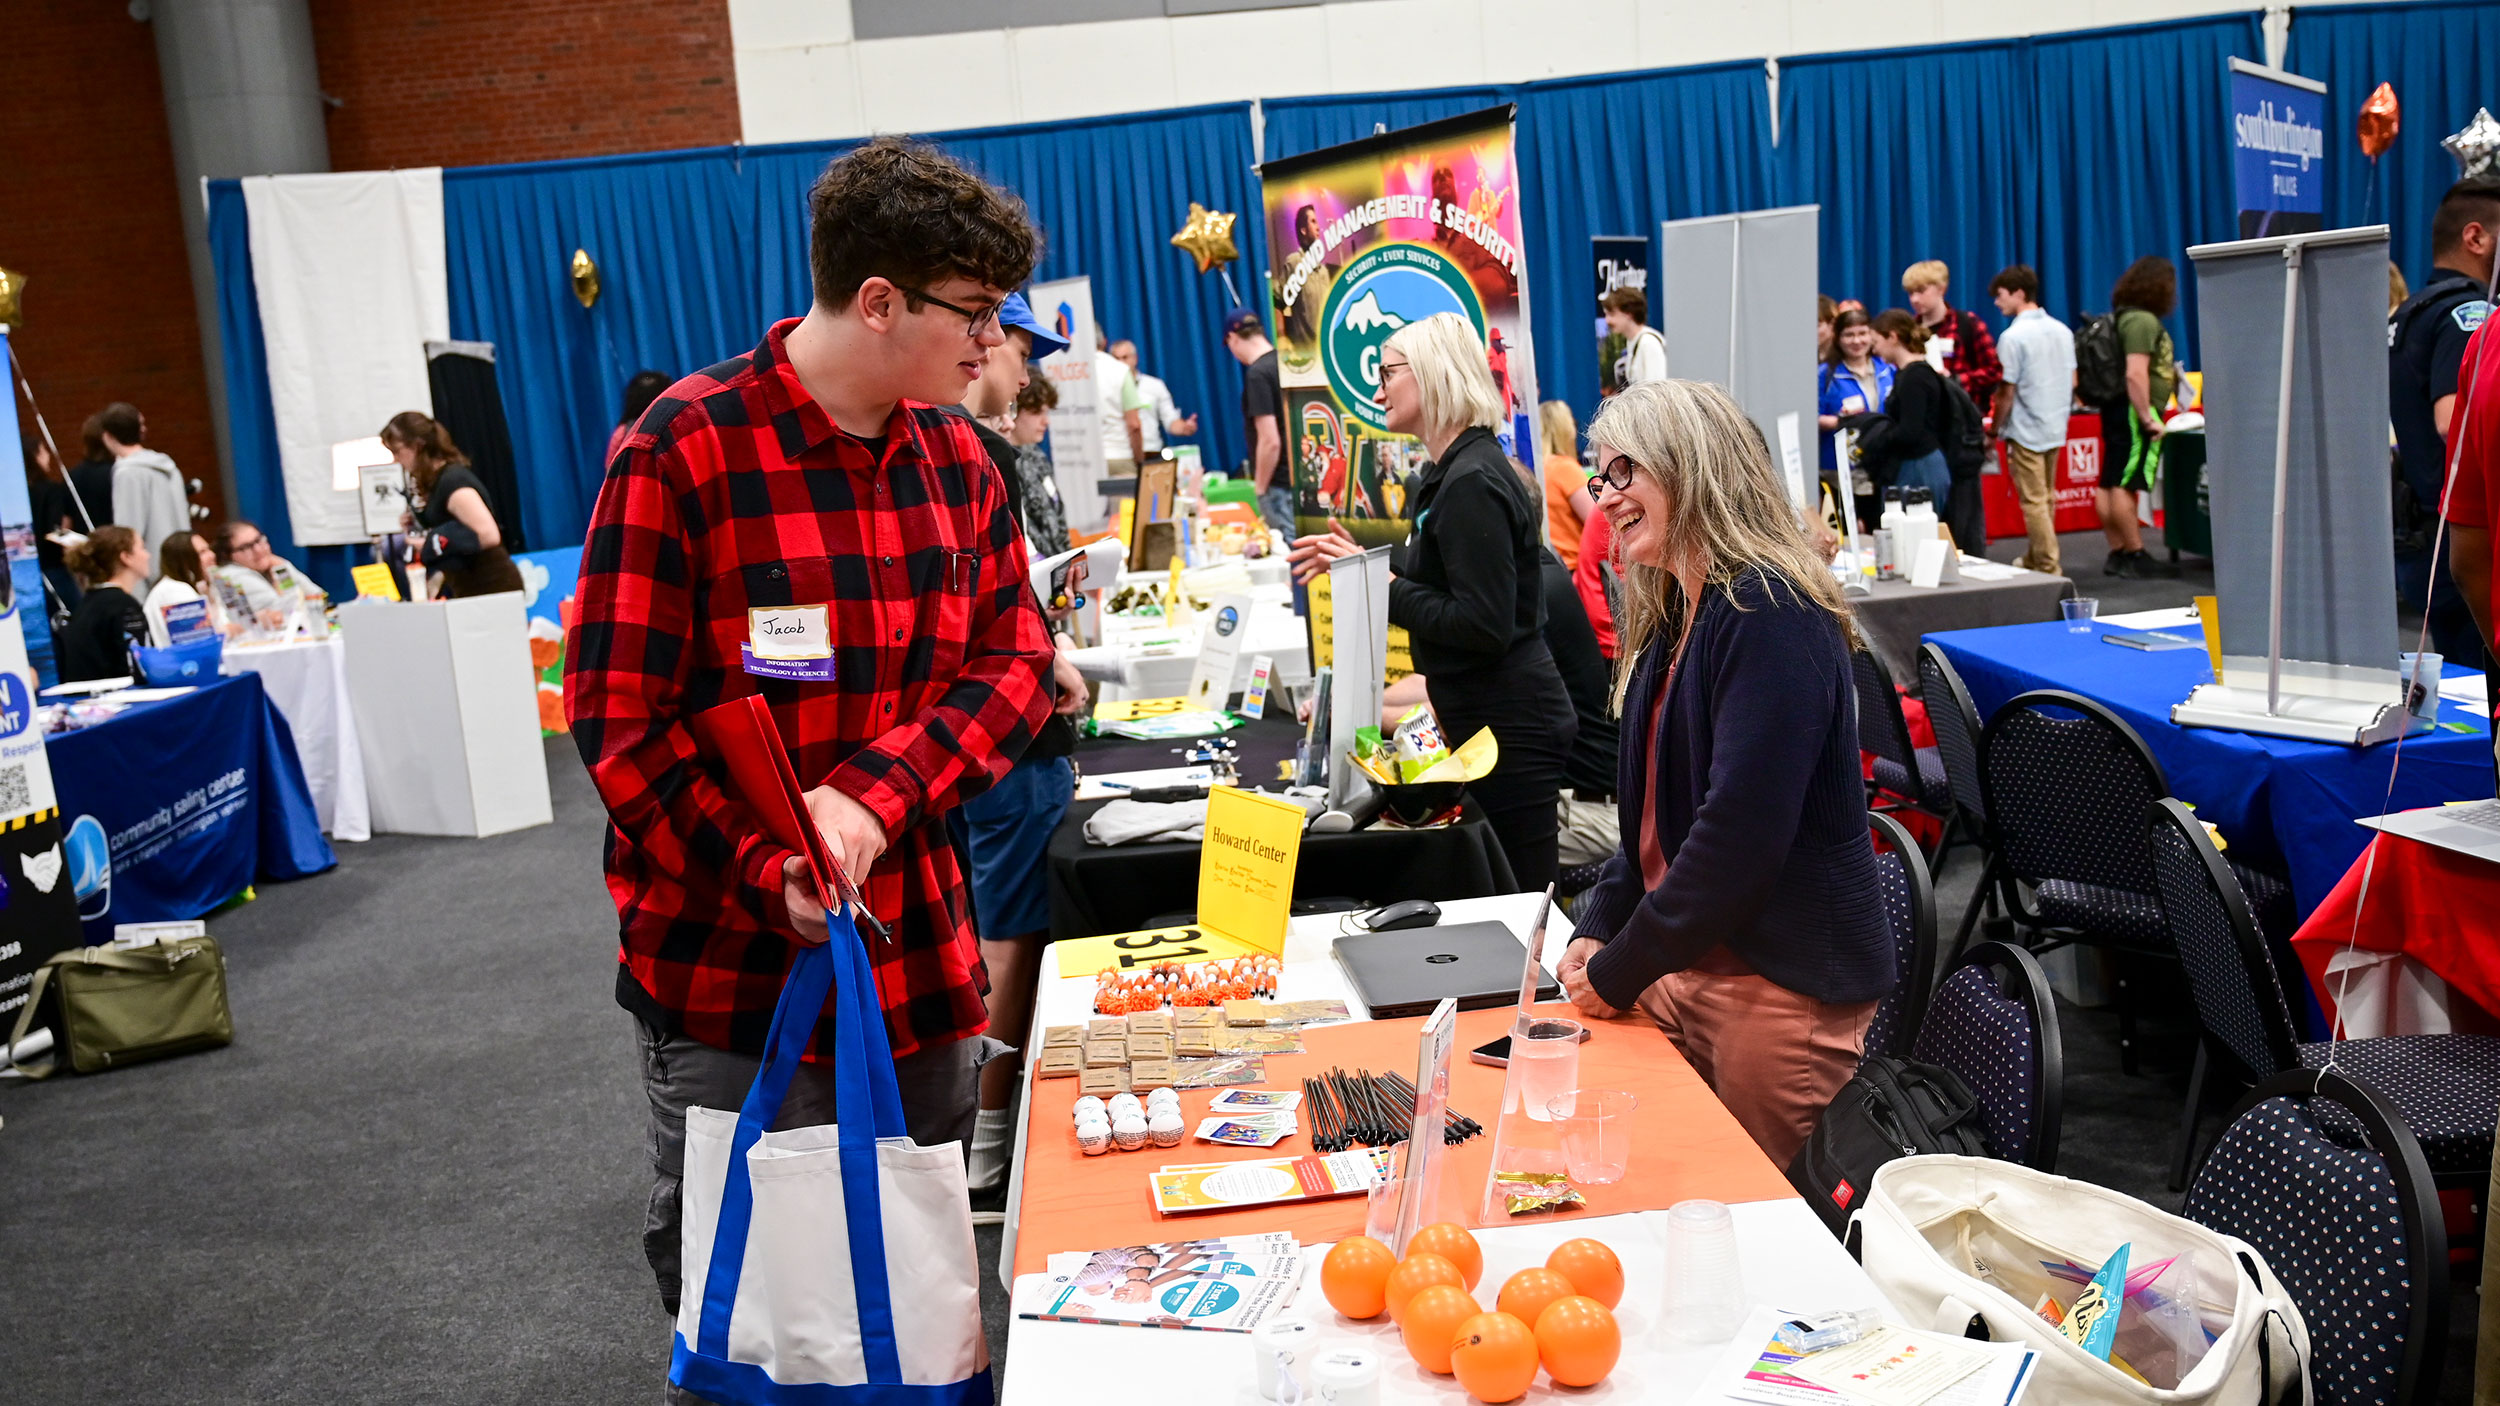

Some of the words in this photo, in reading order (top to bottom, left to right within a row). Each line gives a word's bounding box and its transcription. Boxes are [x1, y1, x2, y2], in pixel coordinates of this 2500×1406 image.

[1282, 240, 1326, 307] CROWD
[1323, 194, 1427, 252] MANAGEMENT
[1428, 198, 1442, 224] &
[1445, 203, 1518, 276] SECURITY
[1344, 255, 1377, 285] SECURITY
[1382, 249, 1405, 262] EVENT
[1406, 250, 1441, 272] SERVICES
[1354, 400, 1374, 421] YOUR
[762, 617, 805, 635] Jacob
[750, 665, 792, 676] TECHNOLOGY
[110, 804, 173, 851] community
[173, 784, 208, 819] sailing
[208, 767, 247, 798] center
[1212, 826, 1250, 853] Howard
[1252, 838, 1287, 864] Center
[1114, 929, 1208, 968] 31
[1282, 1256, 1296, 1276] Suicide
[1258, 1280, 1275, 1298] Across
[1267, 1280, 1286, 1300] Suicide
[1198, 1301, 1218, 1316] Call
[1237, 1305, 1257, 1328] Lifespan
[1248, 1299, 1273, 1328] Prevention
